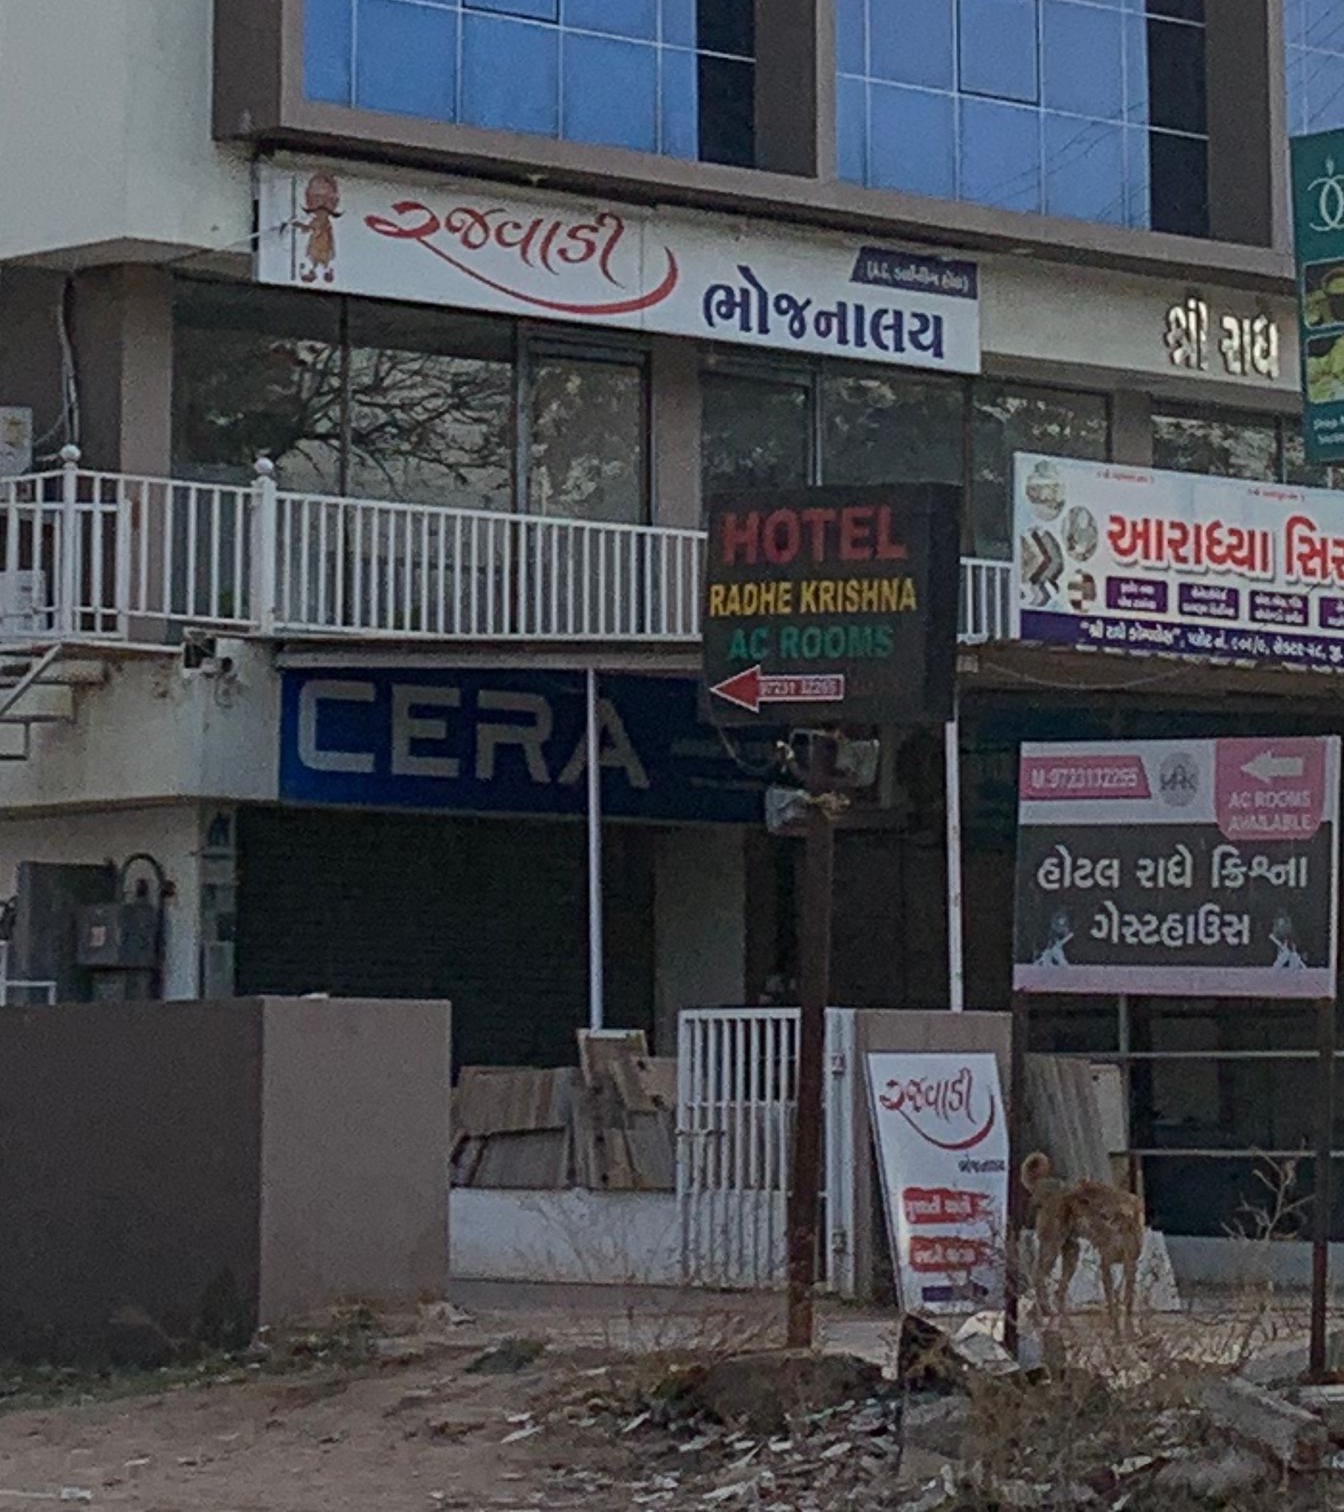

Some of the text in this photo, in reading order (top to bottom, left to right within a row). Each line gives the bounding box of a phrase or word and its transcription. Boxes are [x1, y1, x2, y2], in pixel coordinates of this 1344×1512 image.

[364, 200, 678, 316] રજવાડી
[703, 265, 944, 359] ભોજનાલય
[720, 505, 907, 565] HOTEL
[1107, 514, 1270, 574] આરાધ્યા
[709, 577, 917, 617] RADHE KRISHNA
[727, 624, 895, 661] AC ROOMS
[296, 676, 651, 790] CERA
[1036, 845, 1120, 890] હોટલ
[1136, 845, 1193, 890] રાધે
